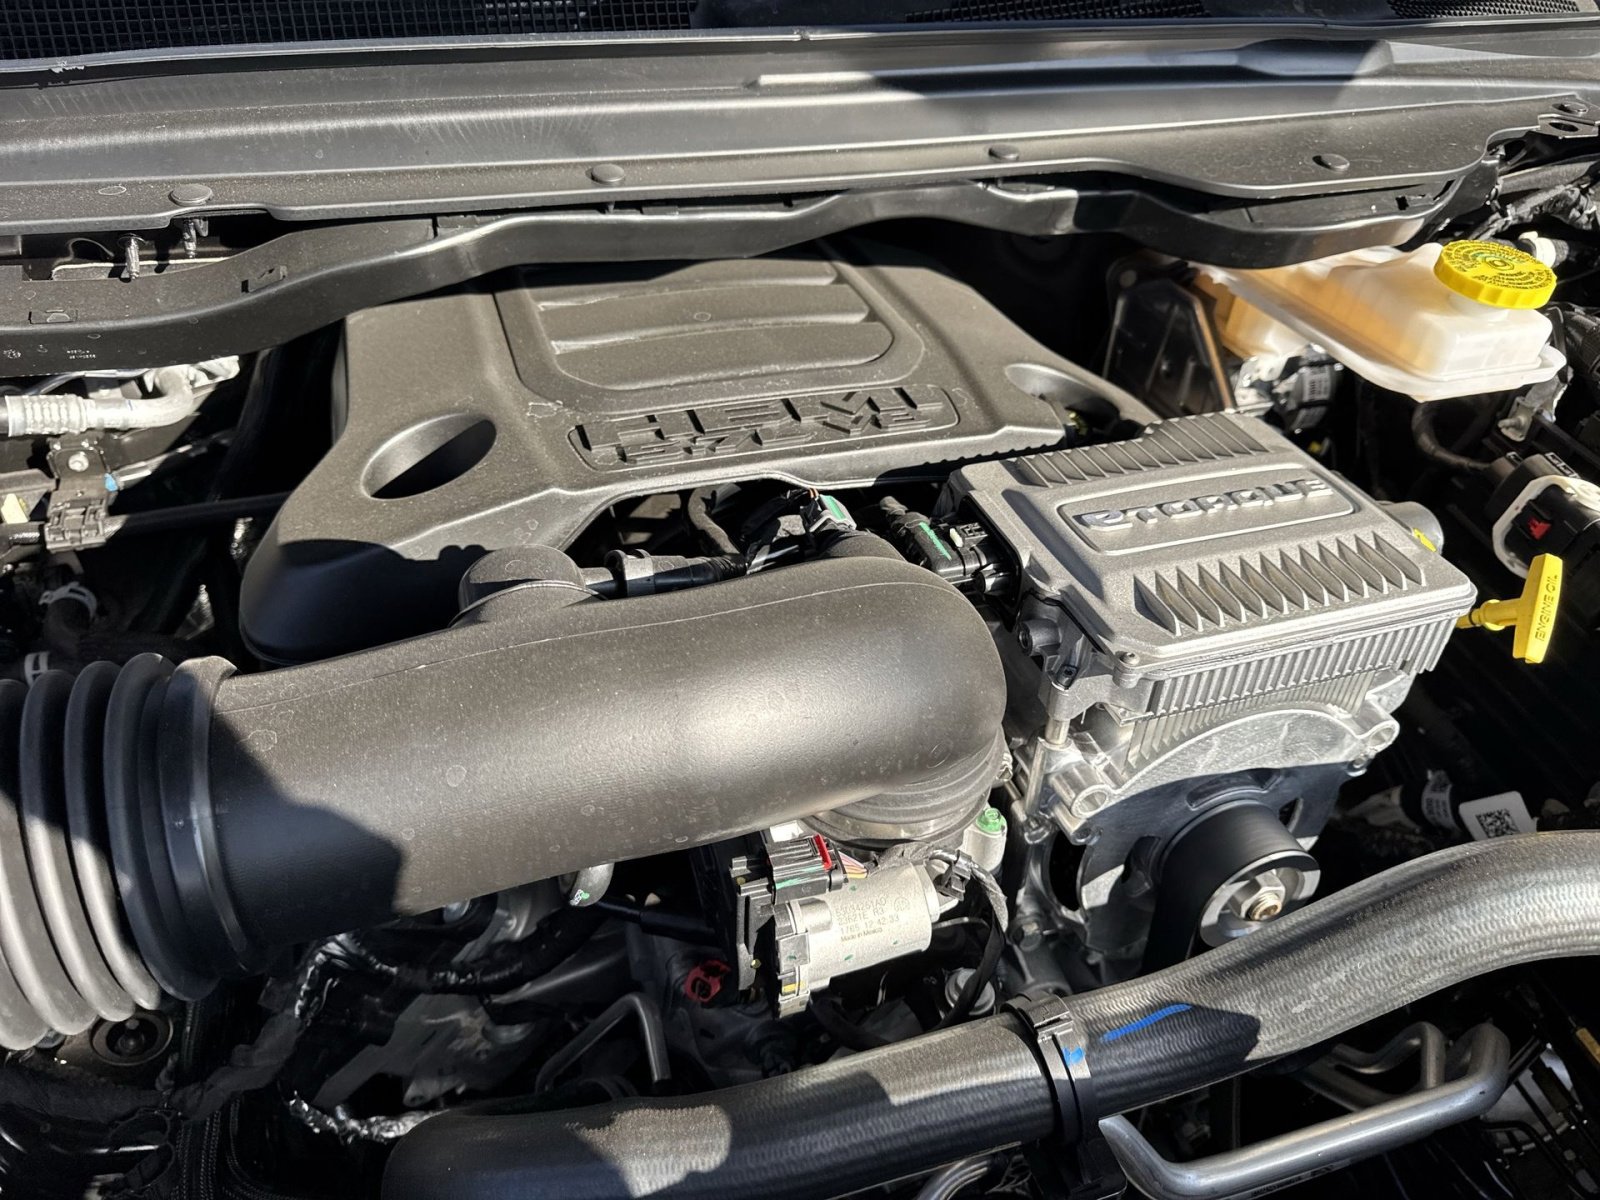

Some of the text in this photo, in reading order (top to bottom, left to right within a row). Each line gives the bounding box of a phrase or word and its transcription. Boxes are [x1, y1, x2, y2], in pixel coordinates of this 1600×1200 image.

[575, 387, 943, 452] HEMI
[1535, 574, 1559, 642] ENGINE OIL
[863, 927, 883, 937] Mexico
